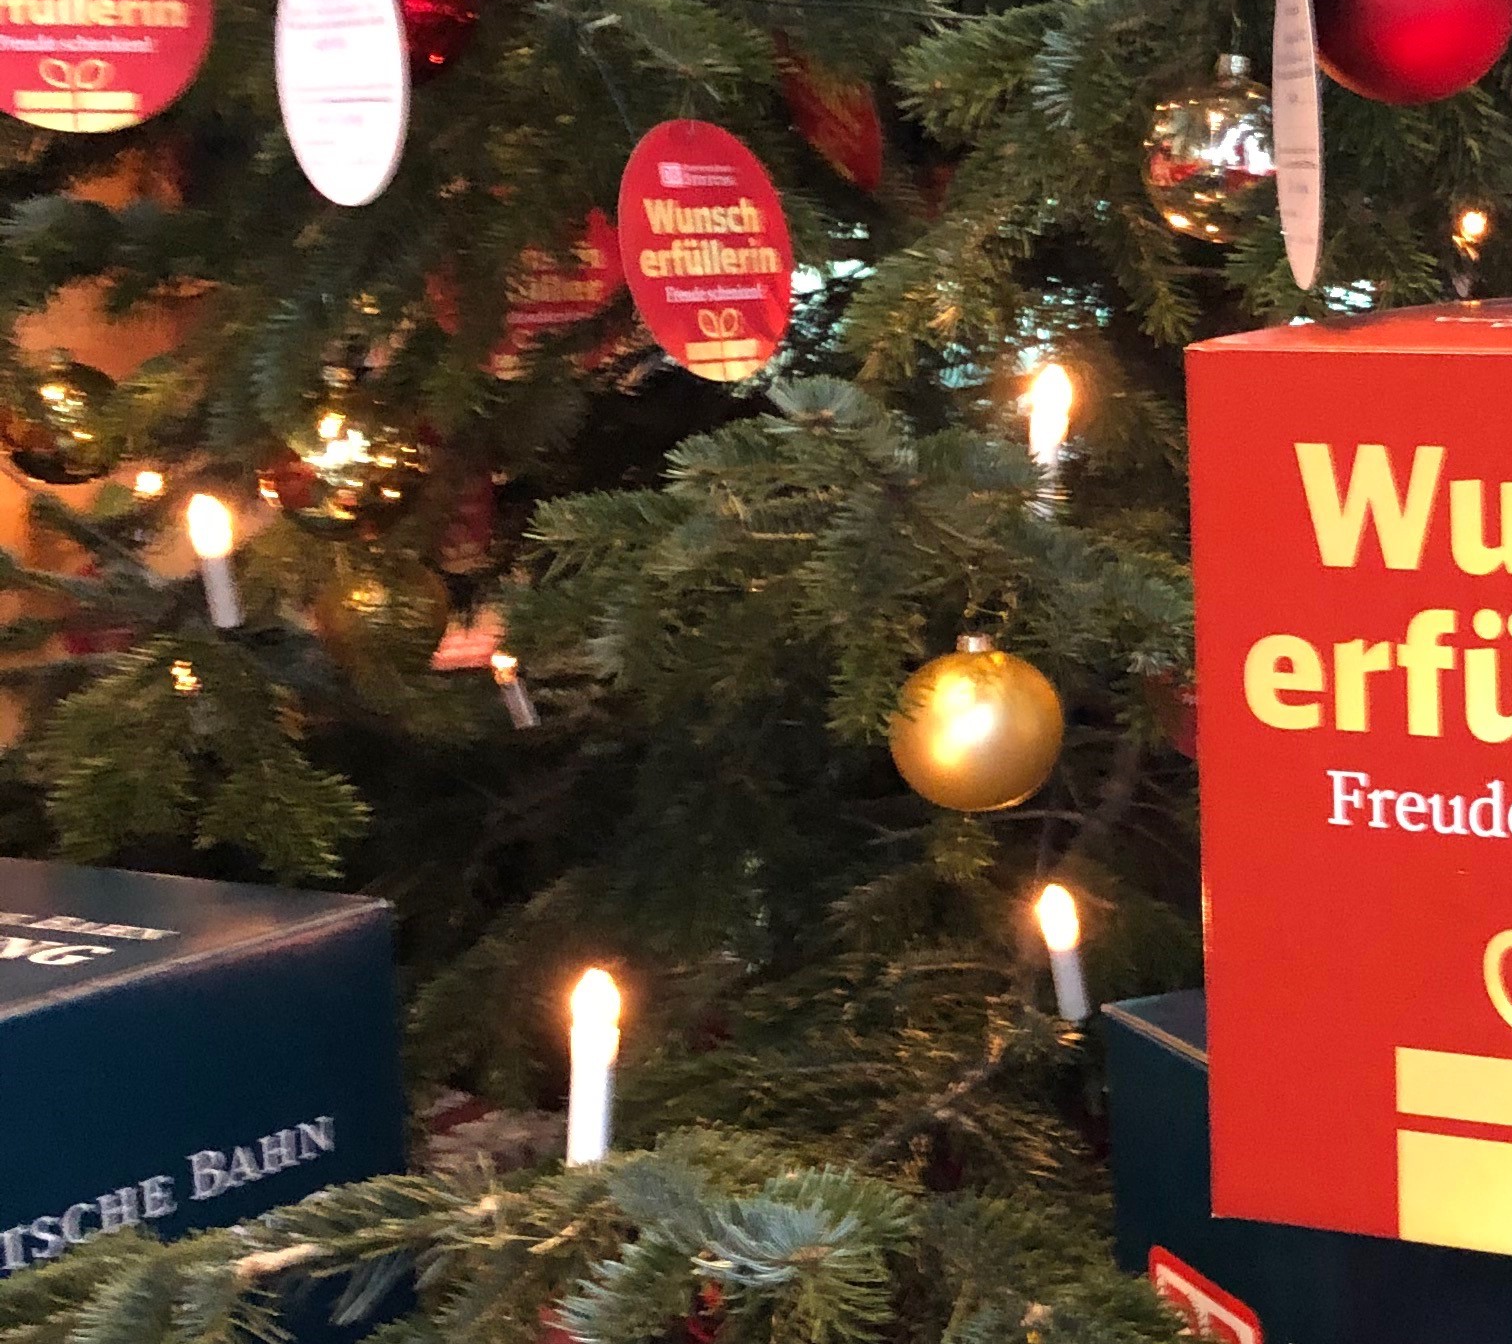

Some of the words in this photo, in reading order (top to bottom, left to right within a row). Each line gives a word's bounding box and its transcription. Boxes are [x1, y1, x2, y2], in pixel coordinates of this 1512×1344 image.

[643, 197, 764, 235] Wunsch
[639, 238, 782, 278] erfüllerin
[186, 1115, 336, 1201] BAHN
